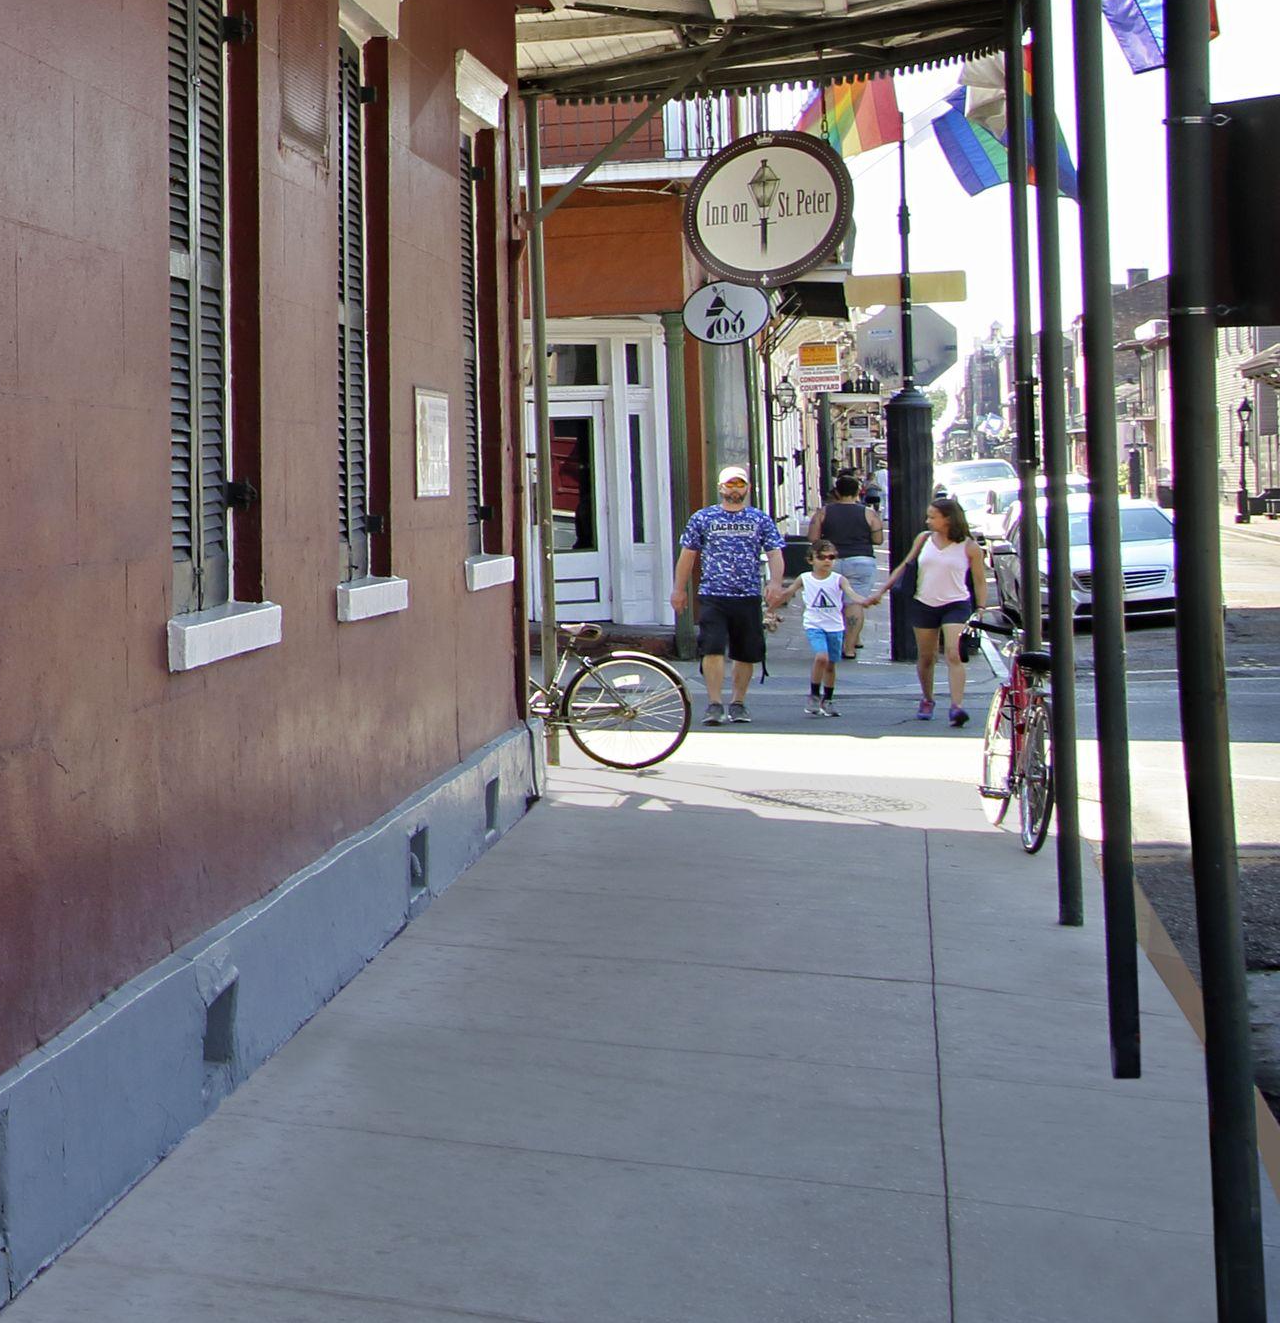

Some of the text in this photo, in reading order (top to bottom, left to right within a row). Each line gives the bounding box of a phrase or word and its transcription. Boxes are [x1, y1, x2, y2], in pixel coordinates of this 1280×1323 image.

[705, 189, 832, 226] Inn on St. Peter
[705, 308, 746, 340] 700
[800, 383, 840, 392] COURTYARD
[711, 523, 755, 531] LACROSSE
